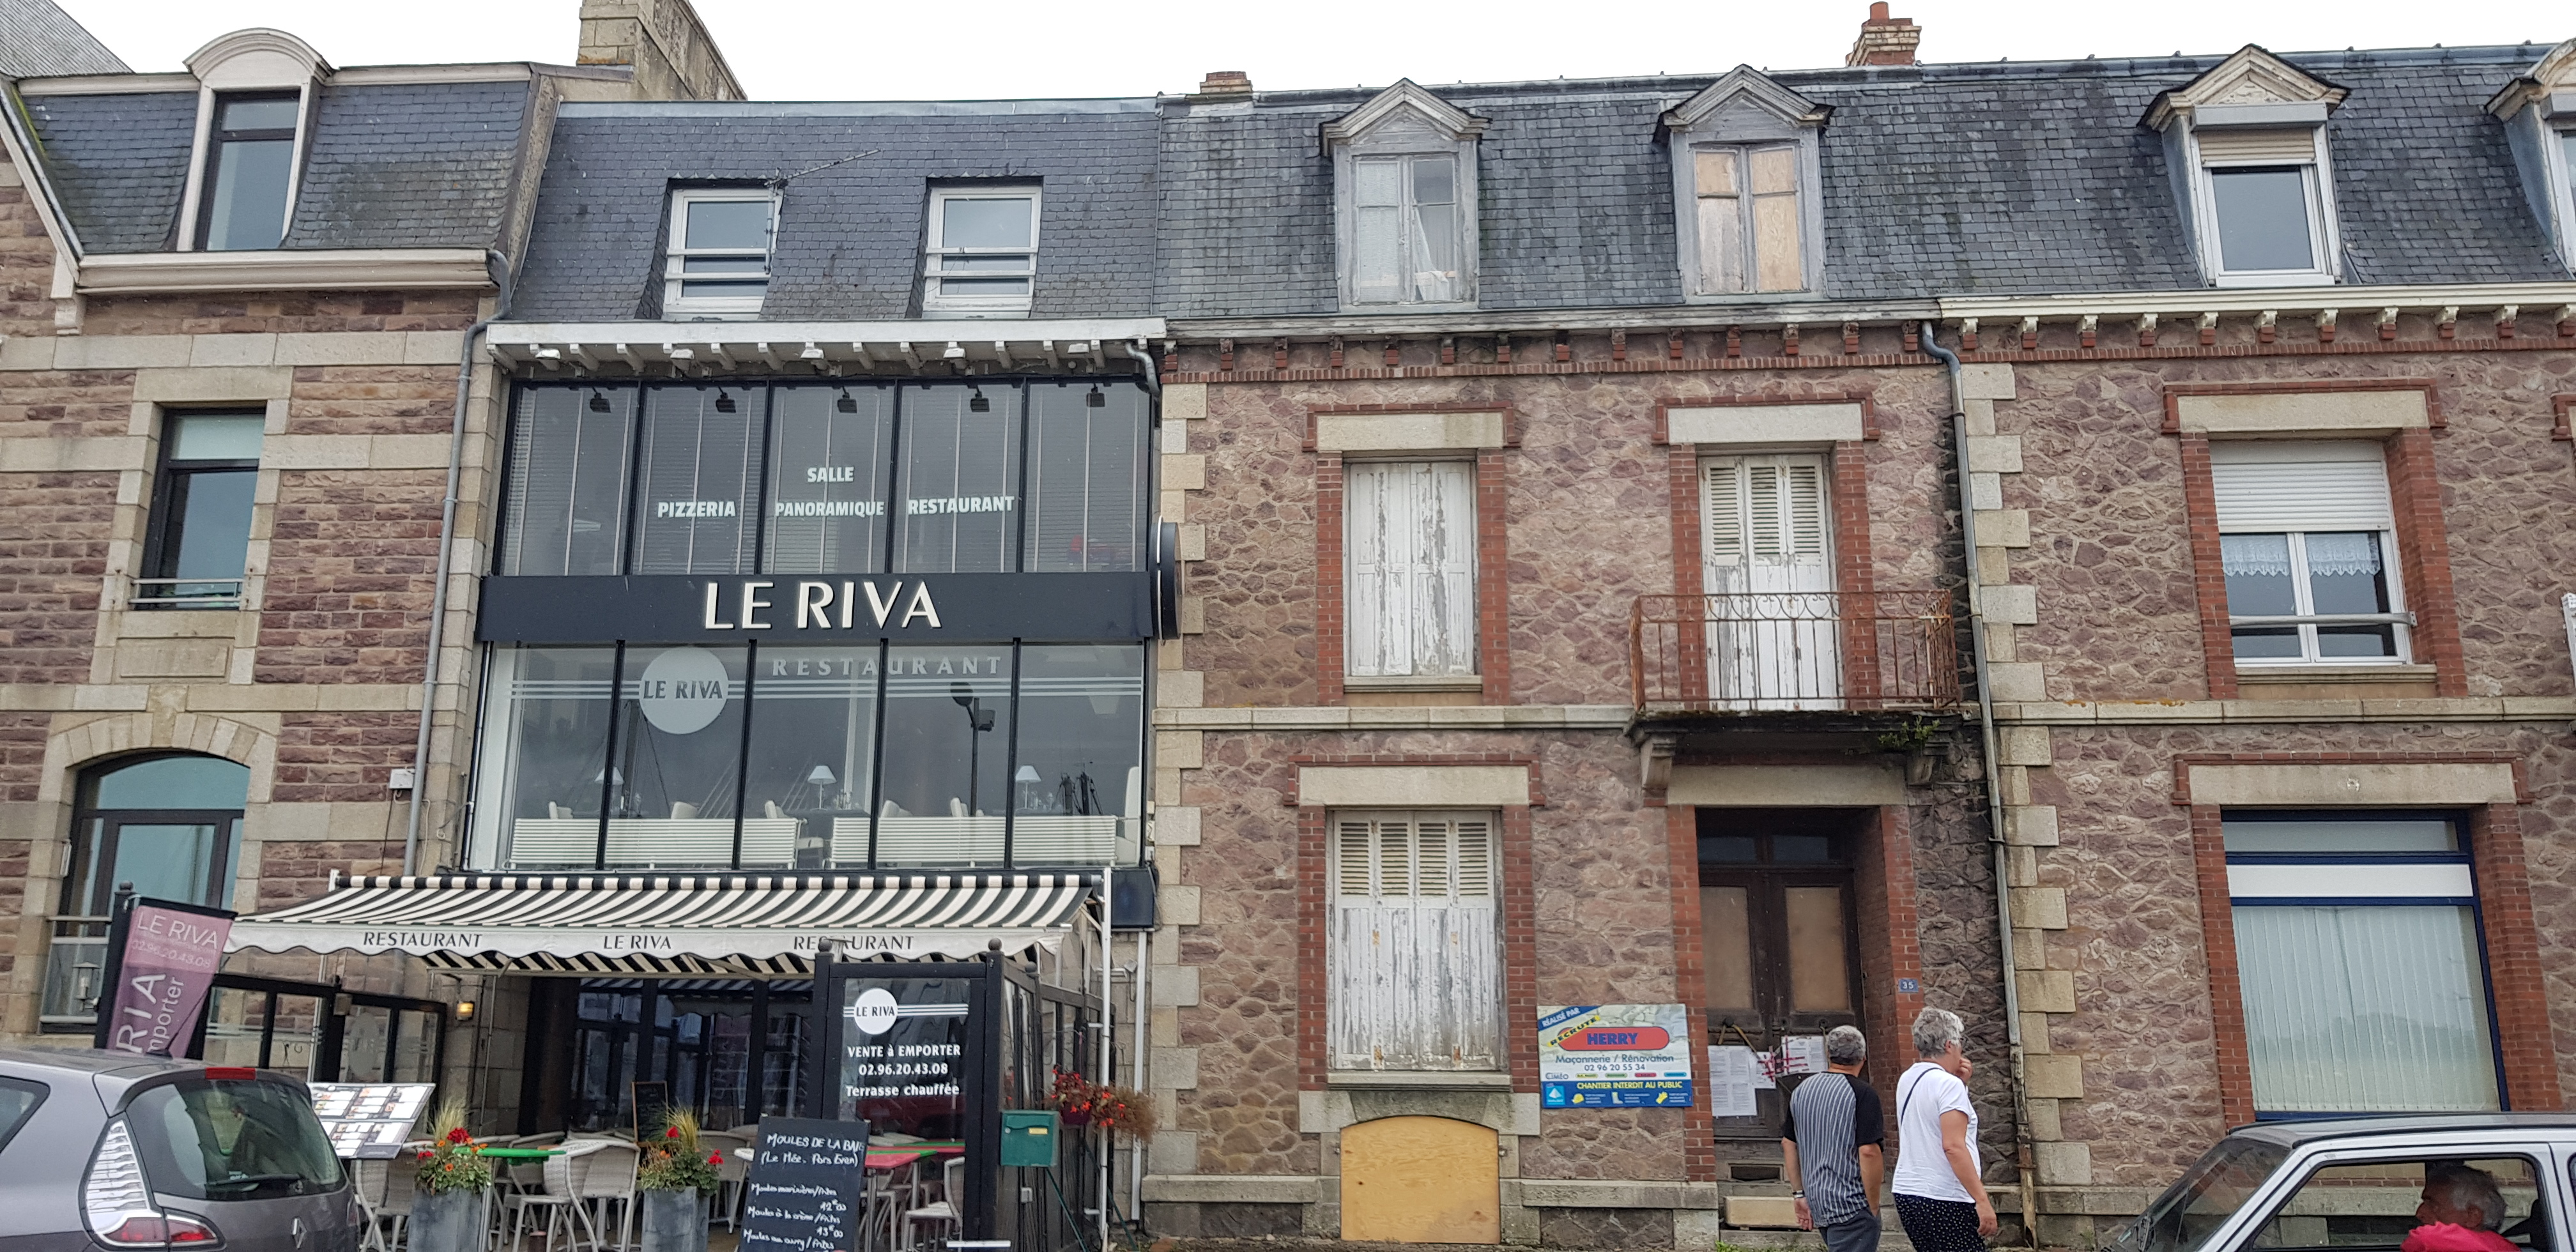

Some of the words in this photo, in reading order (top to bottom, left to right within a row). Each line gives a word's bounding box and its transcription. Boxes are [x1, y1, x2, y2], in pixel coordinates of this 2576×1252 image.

[807, 466, 854, 483] SALLE
[657, 501, 736, 518] PIZZERIA
[775, 501, 885, 518] PANORAMIQUE
[908, 496, 1015, 515] RESTAURANT
[705, 581, 774, 629] LE
[797, 581, 942, 629] RIVA
[772, 656, 1000, 676] RESTAURANT
[643, 680, 666, 699] LE
[675, 680, 723, 699] RIVA
[137, 912, 166, 934] LE
[168, 920, 218, 949] RIVA
[364, 932, 482, 947] RESTAURANT
[604, 935, 624, 949] LE
[631, 935, 671, 949] RIVA
[856, 1007, 868, 1017] LE
[872, 1006, 895, 1017] RIVA
[1566, 1007, 1581, 1018] PAR
[1550, 1017, 1597, 1046] RECRUTE
[1587, 1033, 1638, 1045] HERRY
[847, 1046, 884, 1057] VENTE
[887, 1044, 894, 1057] à
[898, 1044, 961, 1057] EMPORTER
[1556, 1055, 1611, 1065] Maçonnerie
[1621, 1054, 1674, 1063] Rénovation
[859, 1062, 948, 1075] 02.96.20.43.08
[846, 1085, 899, 1097] Terrasse
[904, 1083, 960, 1096] chauffée
[767, 1133, 809, 1148] MOULES
[811, 1137, 825, 1148] DE
[827, 1138, 841, 1149] LA
